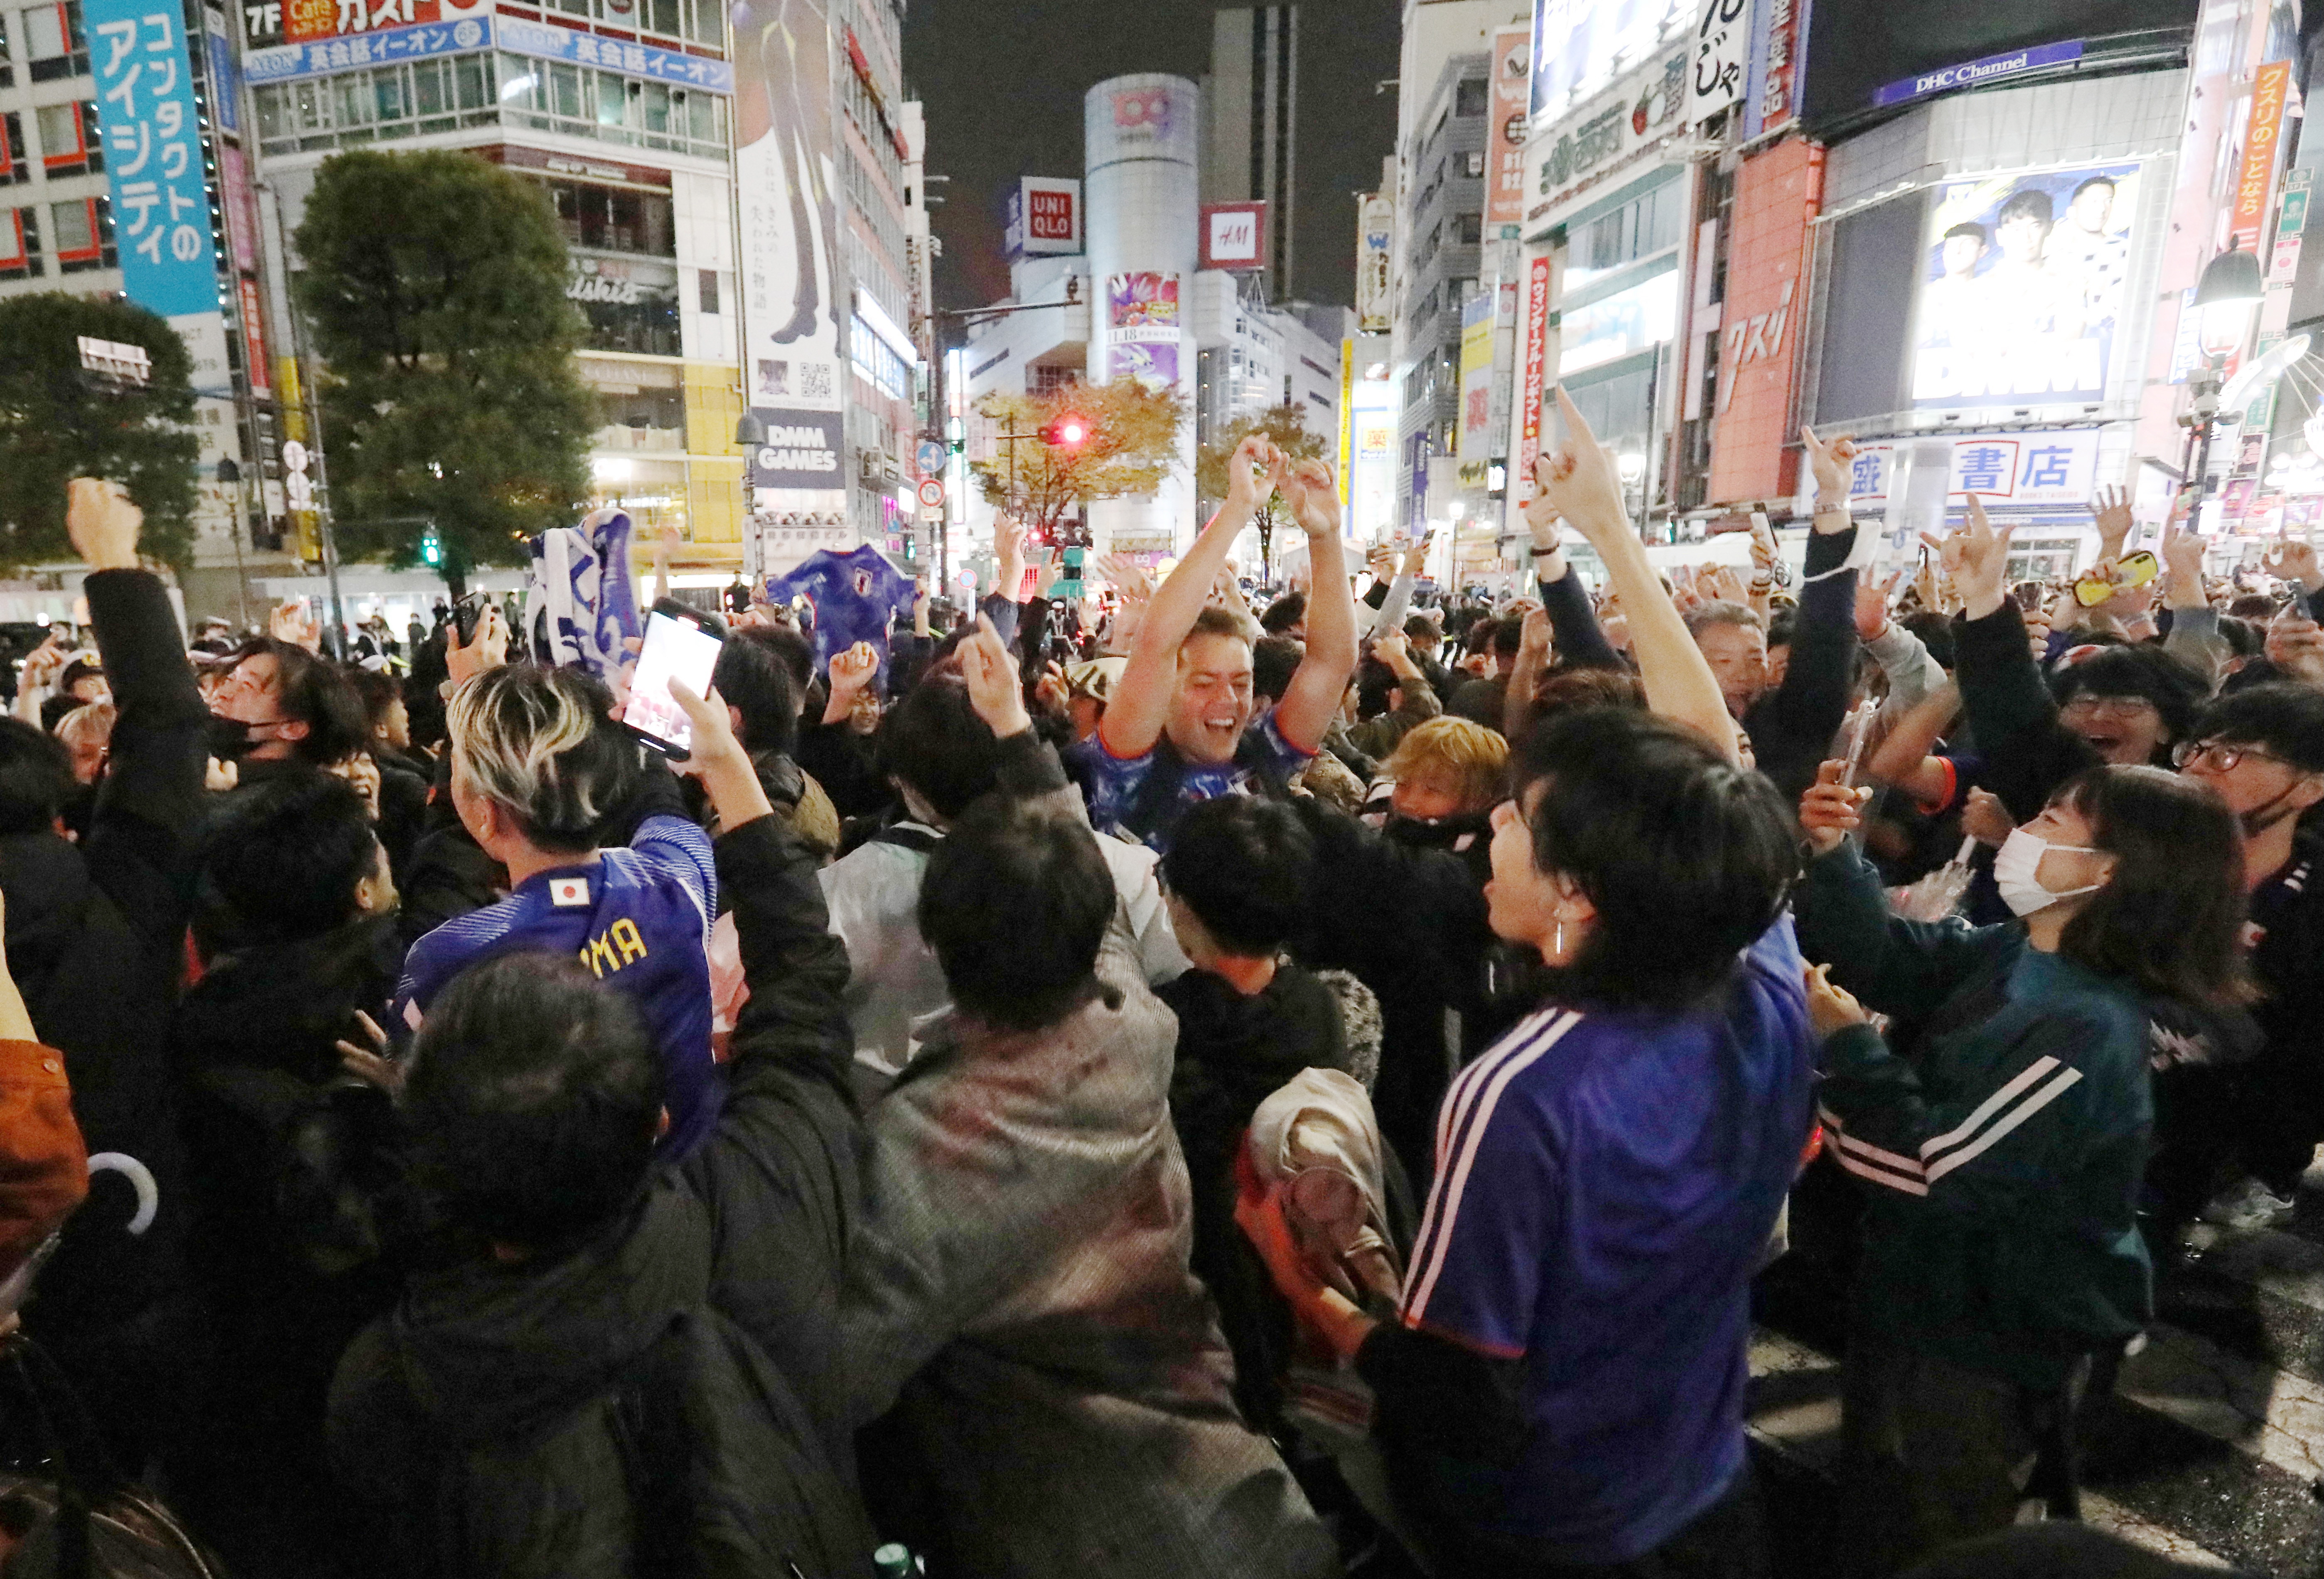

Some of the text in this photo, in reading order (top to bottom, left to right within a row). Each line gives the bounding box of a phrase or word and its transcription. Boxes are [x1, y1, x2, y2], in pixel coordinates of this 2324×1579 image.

[246, 2, 282, 36] 7F
[1916, 53, 2028, 93] DHC Channel
[96, 19, 165, 265] アイシティ
[143, 12, 201, 261] コンタクトの
[2240, 69, 2283, 215] クスリのことなら
[1034, 196, 1065, 214] UNI
[1034, 215, 1069, 235] QLO
[1720, 278, 1796, 413] クスリ
[768, 425, 826, 448] DMM
[758, 447, 837, 471] GAMES
[580, 918, 648, 979] MA
